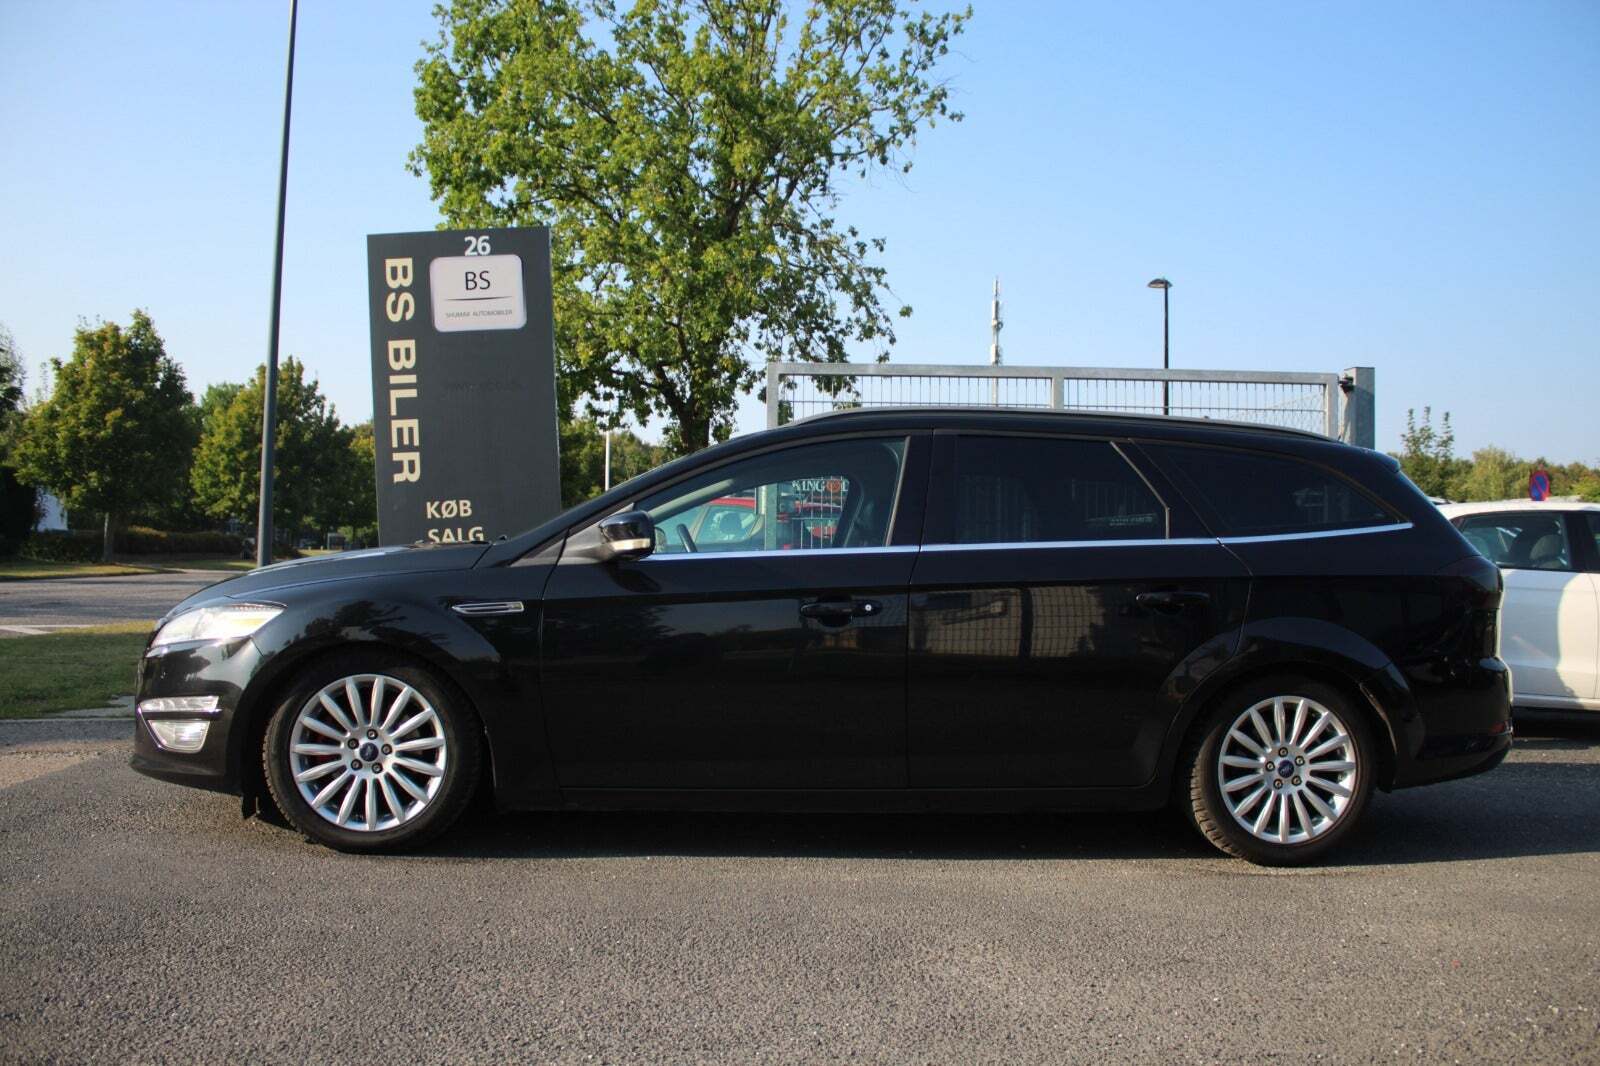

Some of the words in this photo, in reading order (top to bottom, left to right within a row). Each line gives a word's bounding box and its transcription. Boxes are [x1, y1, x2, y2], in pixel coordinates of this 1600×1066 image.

[464, 235, 492, 256] 26
[385, 257, 415, 323] BS
[464, 270, 491, 291] BS
[388, 339, 421, 484] BILER
[426, 499, 473, 519] KØB
[427, 526, 485, 544] SALG
